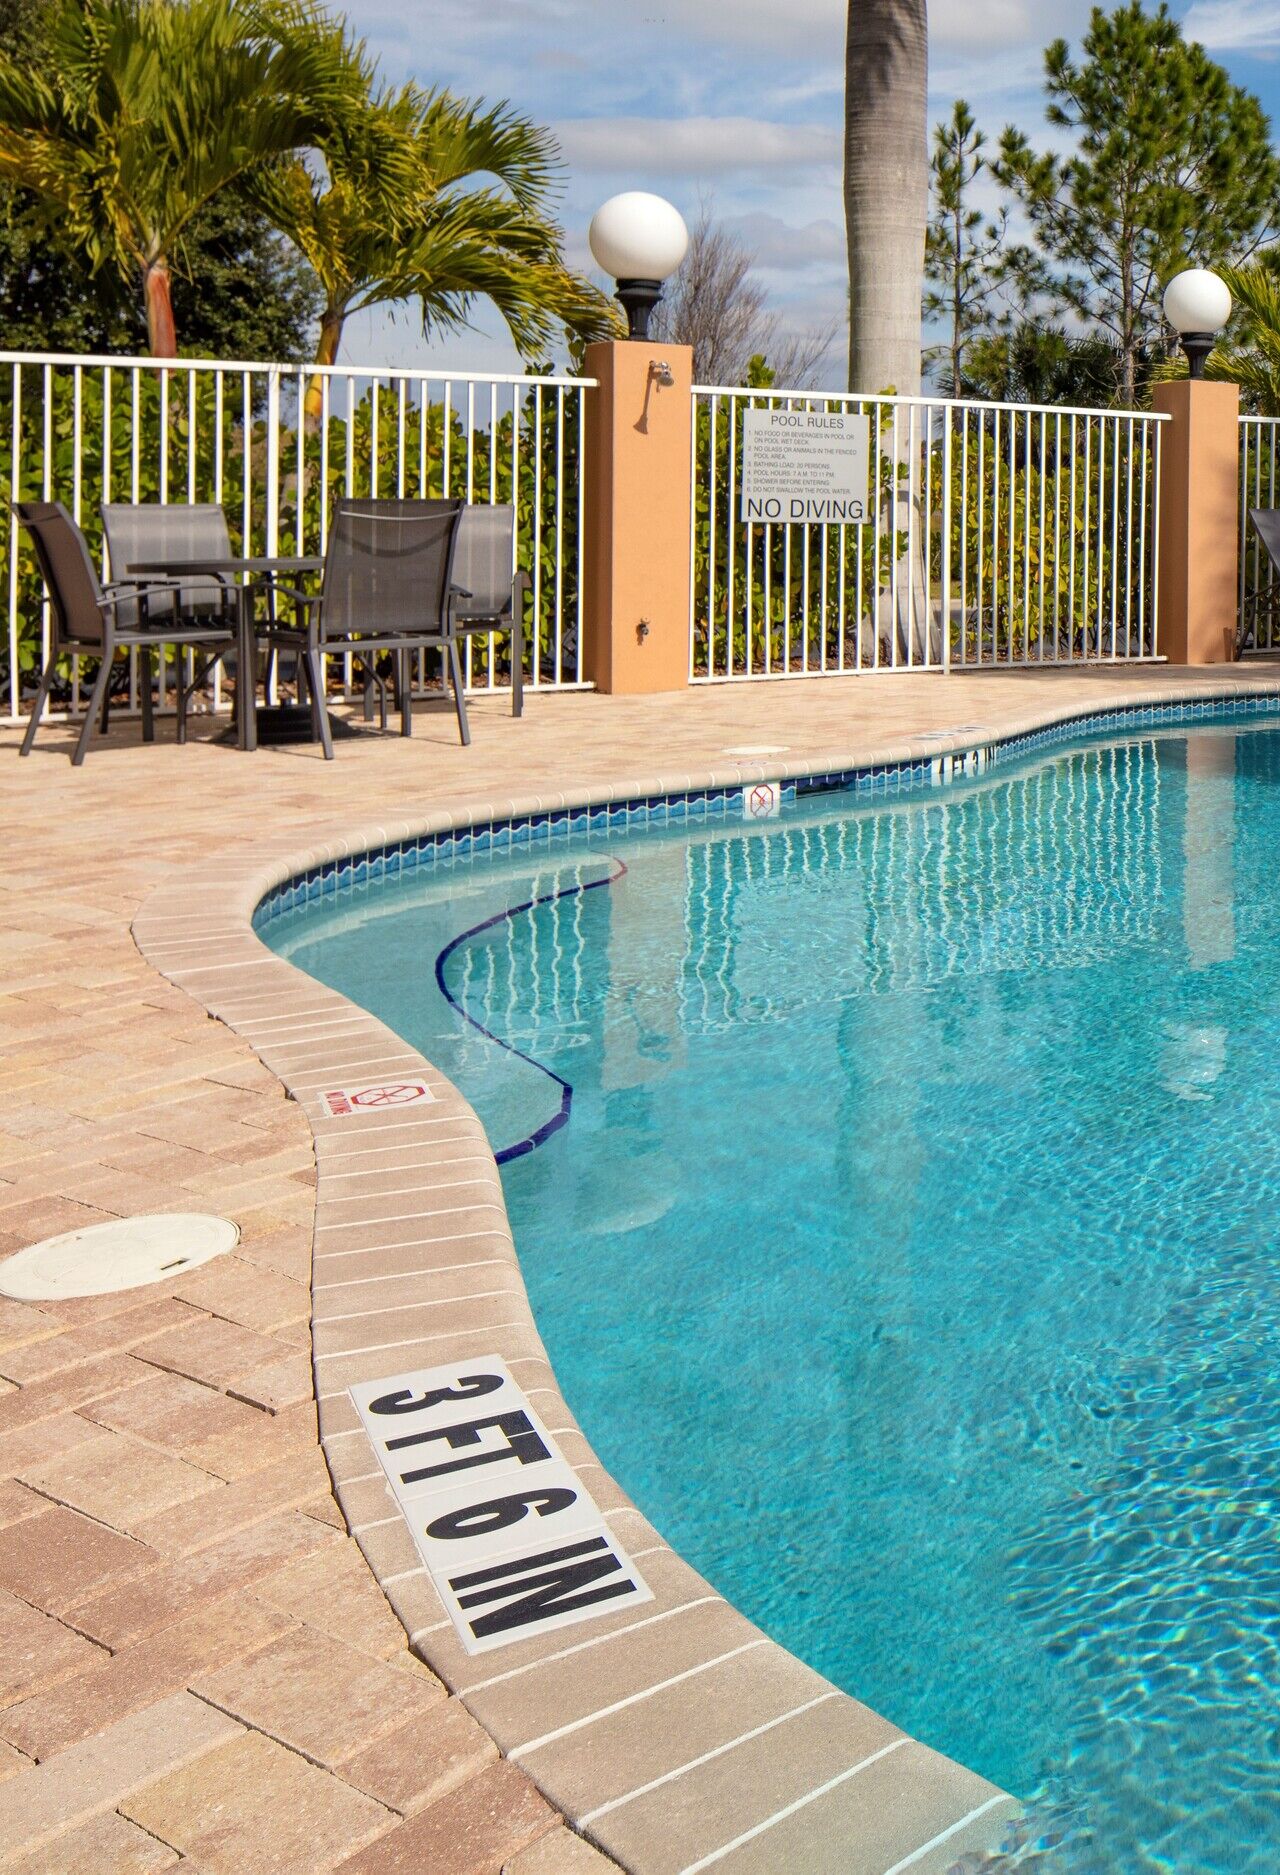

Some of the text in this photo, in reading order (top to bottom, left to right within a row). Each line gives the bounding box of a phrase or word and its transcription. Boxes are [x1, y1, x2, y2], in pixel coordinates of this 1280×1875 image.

[771, 415, 844, 429] POOL RULES
[748, 498, 863, 519] NO DIVING
[368, 1374, 638, 1639] 3 FT 6 IN
